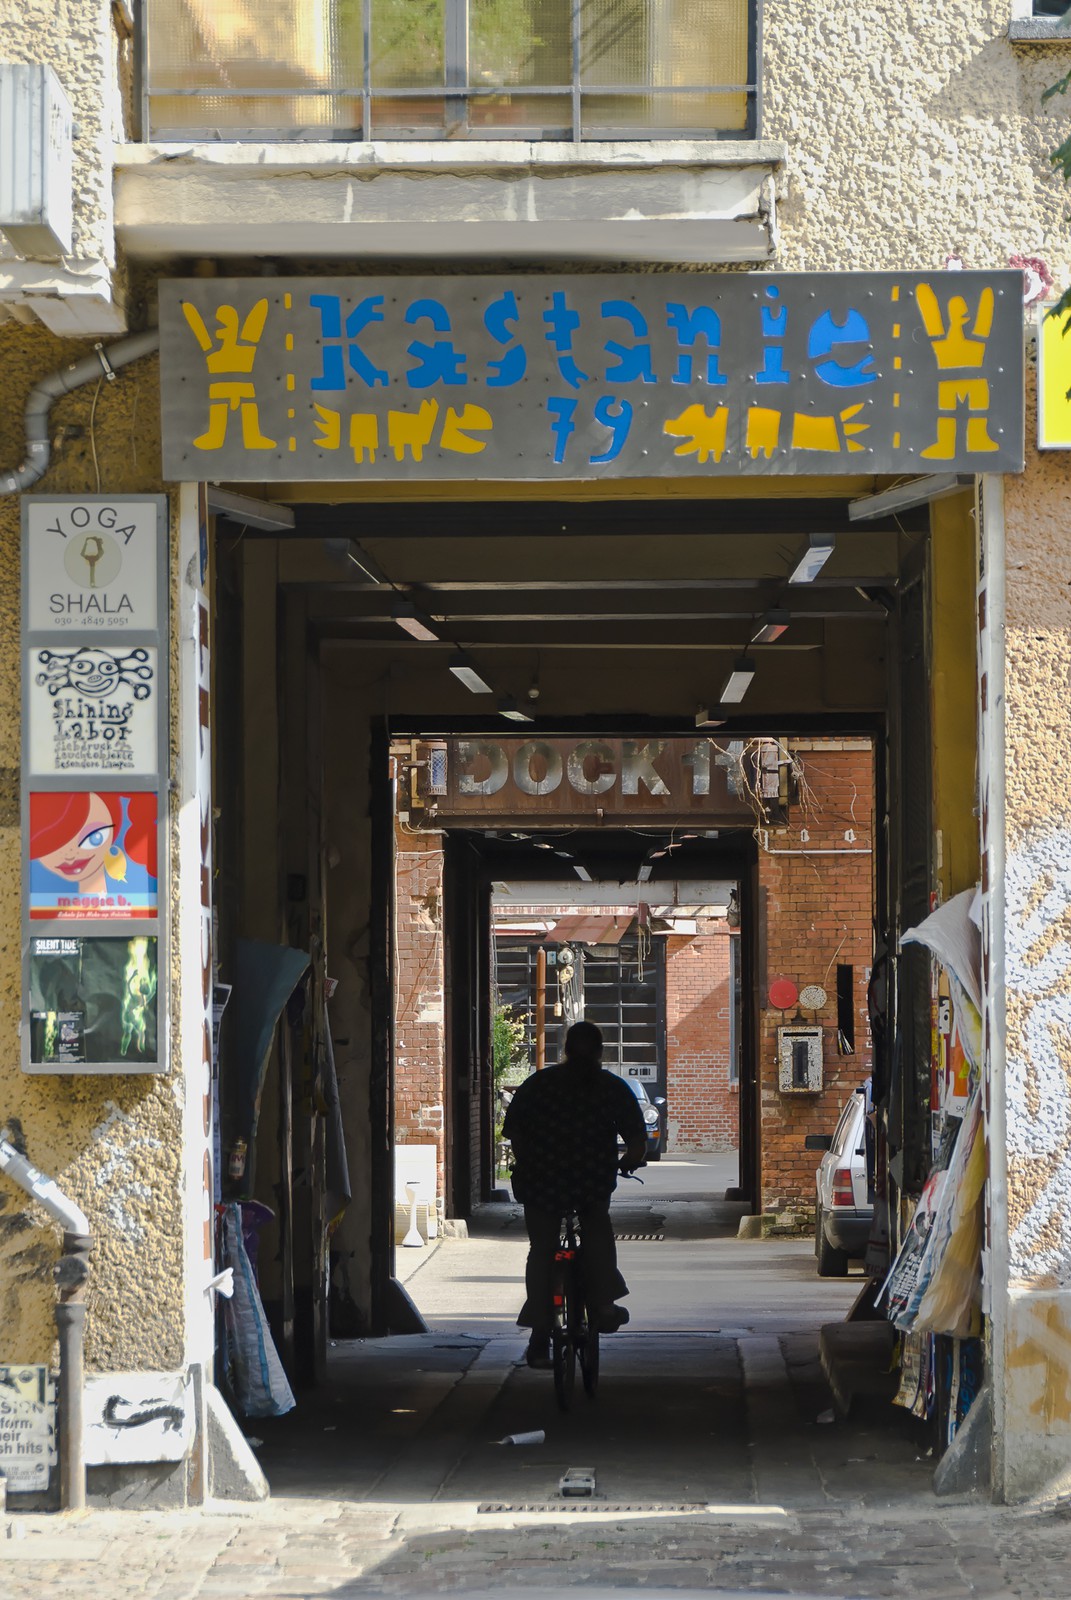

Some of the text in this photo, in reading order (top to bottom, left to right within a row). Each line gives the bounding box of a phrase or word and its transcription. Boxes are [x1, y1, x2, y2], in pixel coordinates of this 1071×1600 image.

[310, 285, 879, 390] Kastanie
[547, 396, 633, 464] 79
[46, 506, 136, 545] YOGA
[49, 593, 134, 613] SHALA
[53, 698, 134, 725] Shining
[54, 719, 132, 741] Labor
[458, 740, 671, 796] DOCK
[35, 939, 60, 950] SILENT
[16, 1442, 43, 1455] hits
